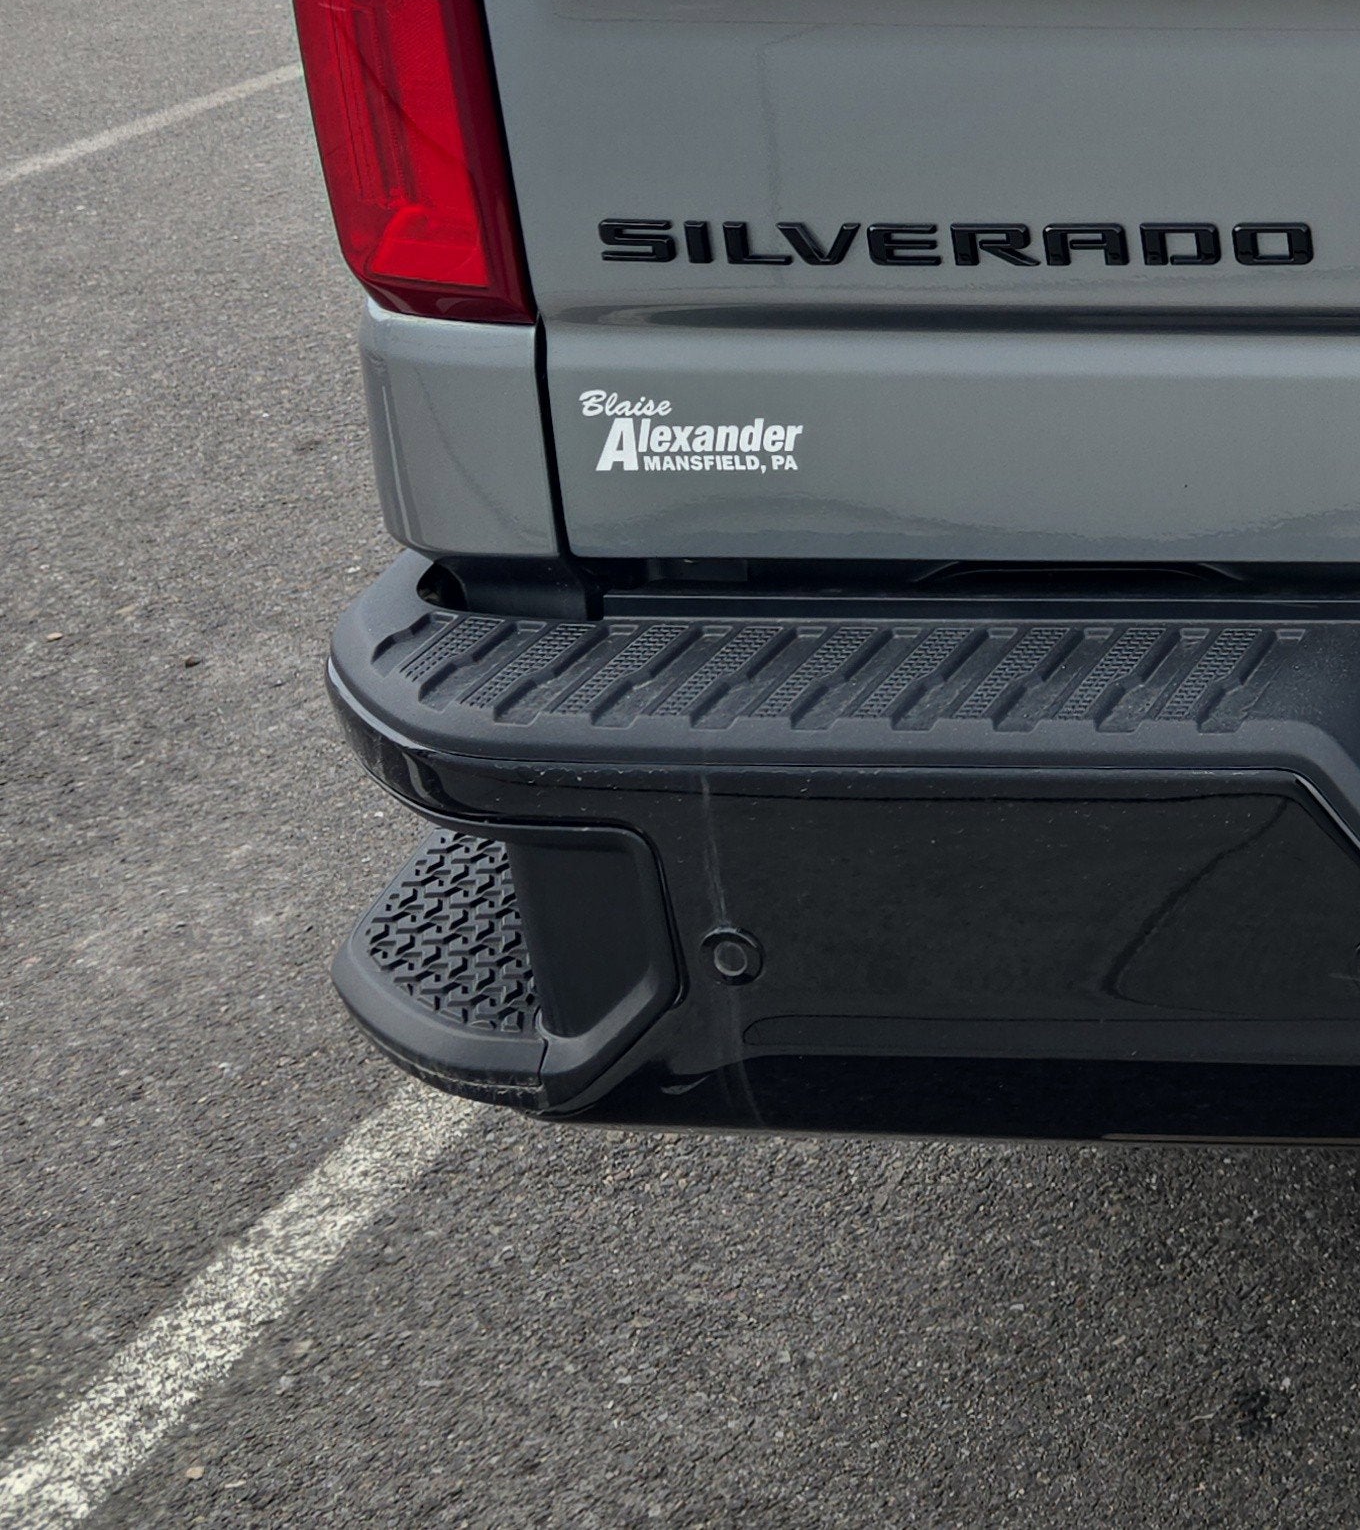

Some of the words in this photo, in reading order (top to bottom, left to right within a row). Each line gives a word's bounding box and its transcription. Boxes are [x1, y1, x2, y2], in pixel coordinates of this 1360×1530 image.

[598, 218, 1315, 267] SILVERADO
[579, 389, 673, 416] Blaise
[595, 417, 804, 471] Alexander
[643, 455, 767, 474] MANSFIELD,
[771, 454, 799, 470] PA
